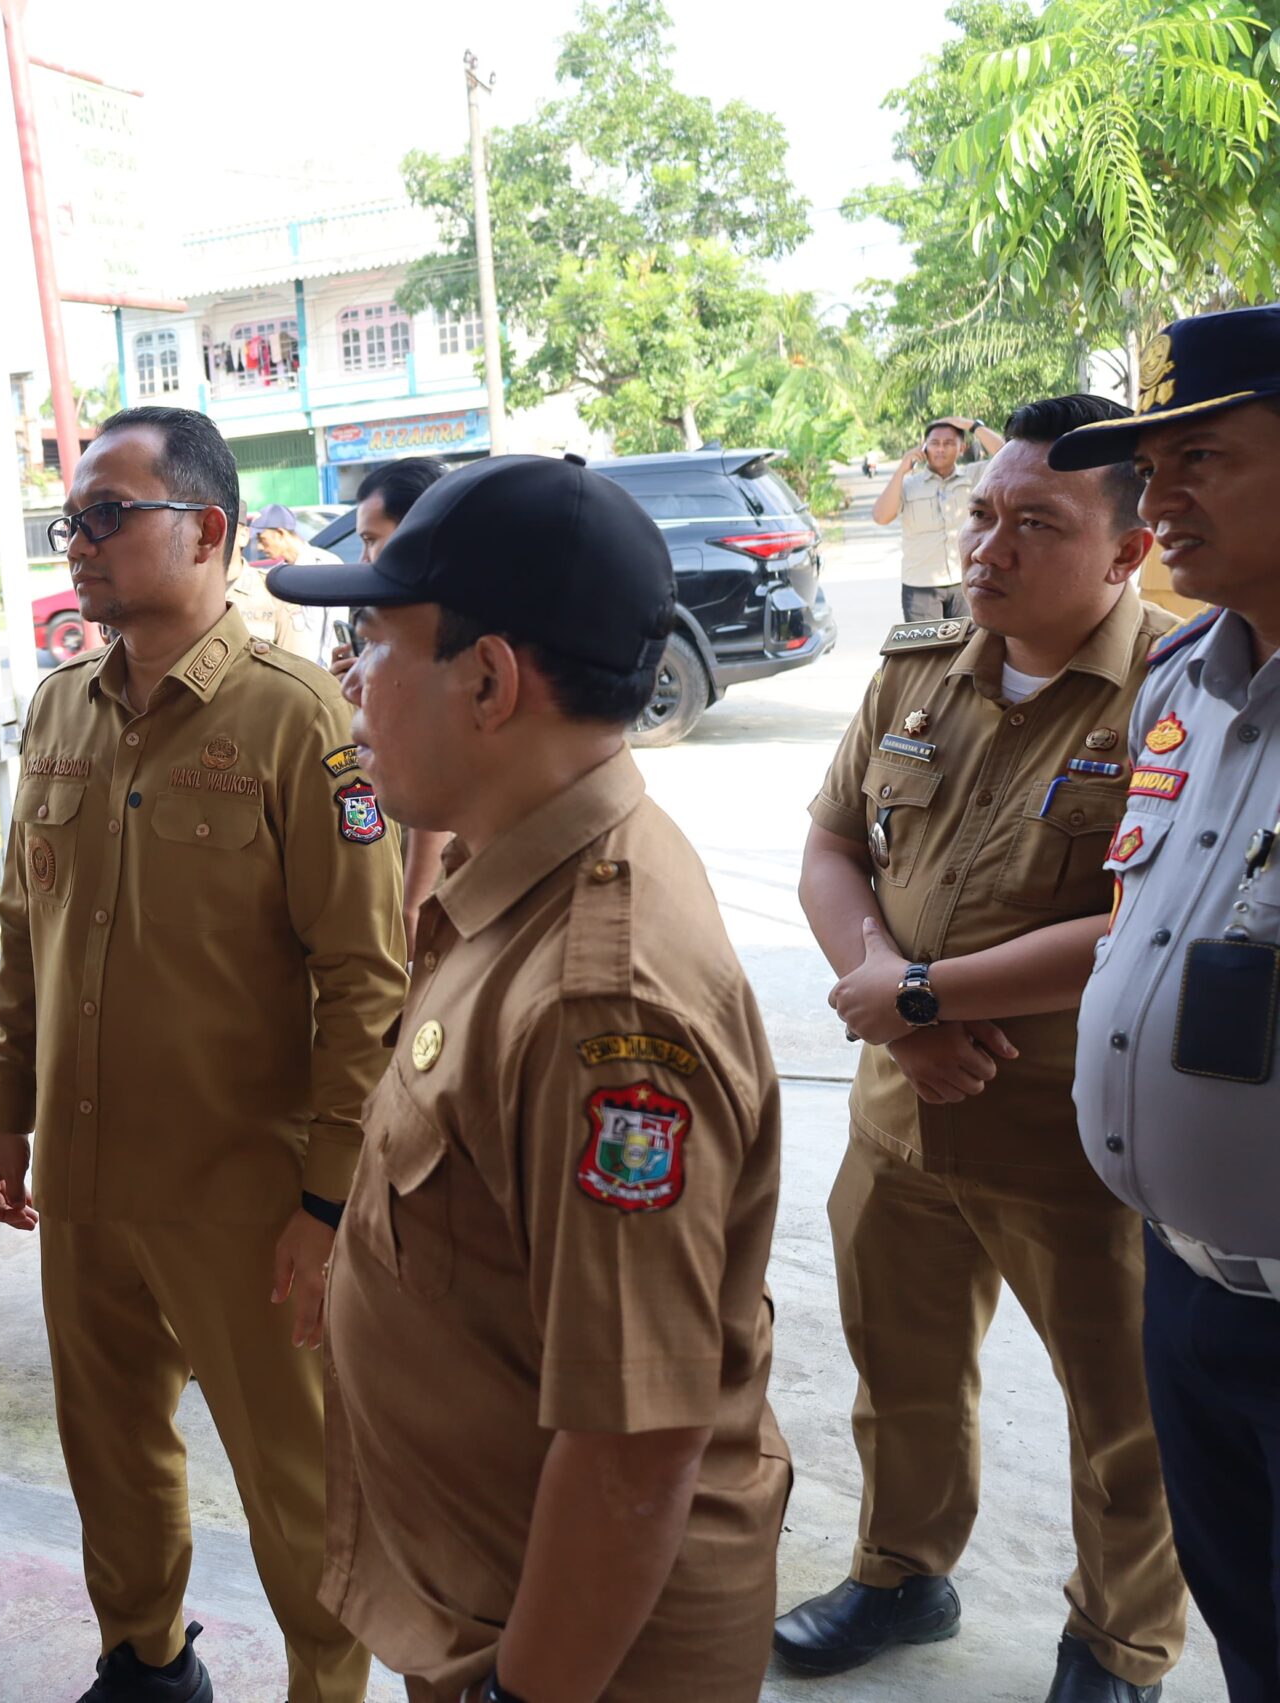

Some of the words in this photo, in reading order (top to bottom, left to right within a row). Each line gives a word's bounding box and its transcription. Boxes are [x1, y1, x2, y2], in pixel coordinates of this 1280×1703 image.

[370, 422, 465, 450] AZZAHRA
[169, 767, 201, 789] WAKIL
[207, 772, 259, 796] WALIKOTA
